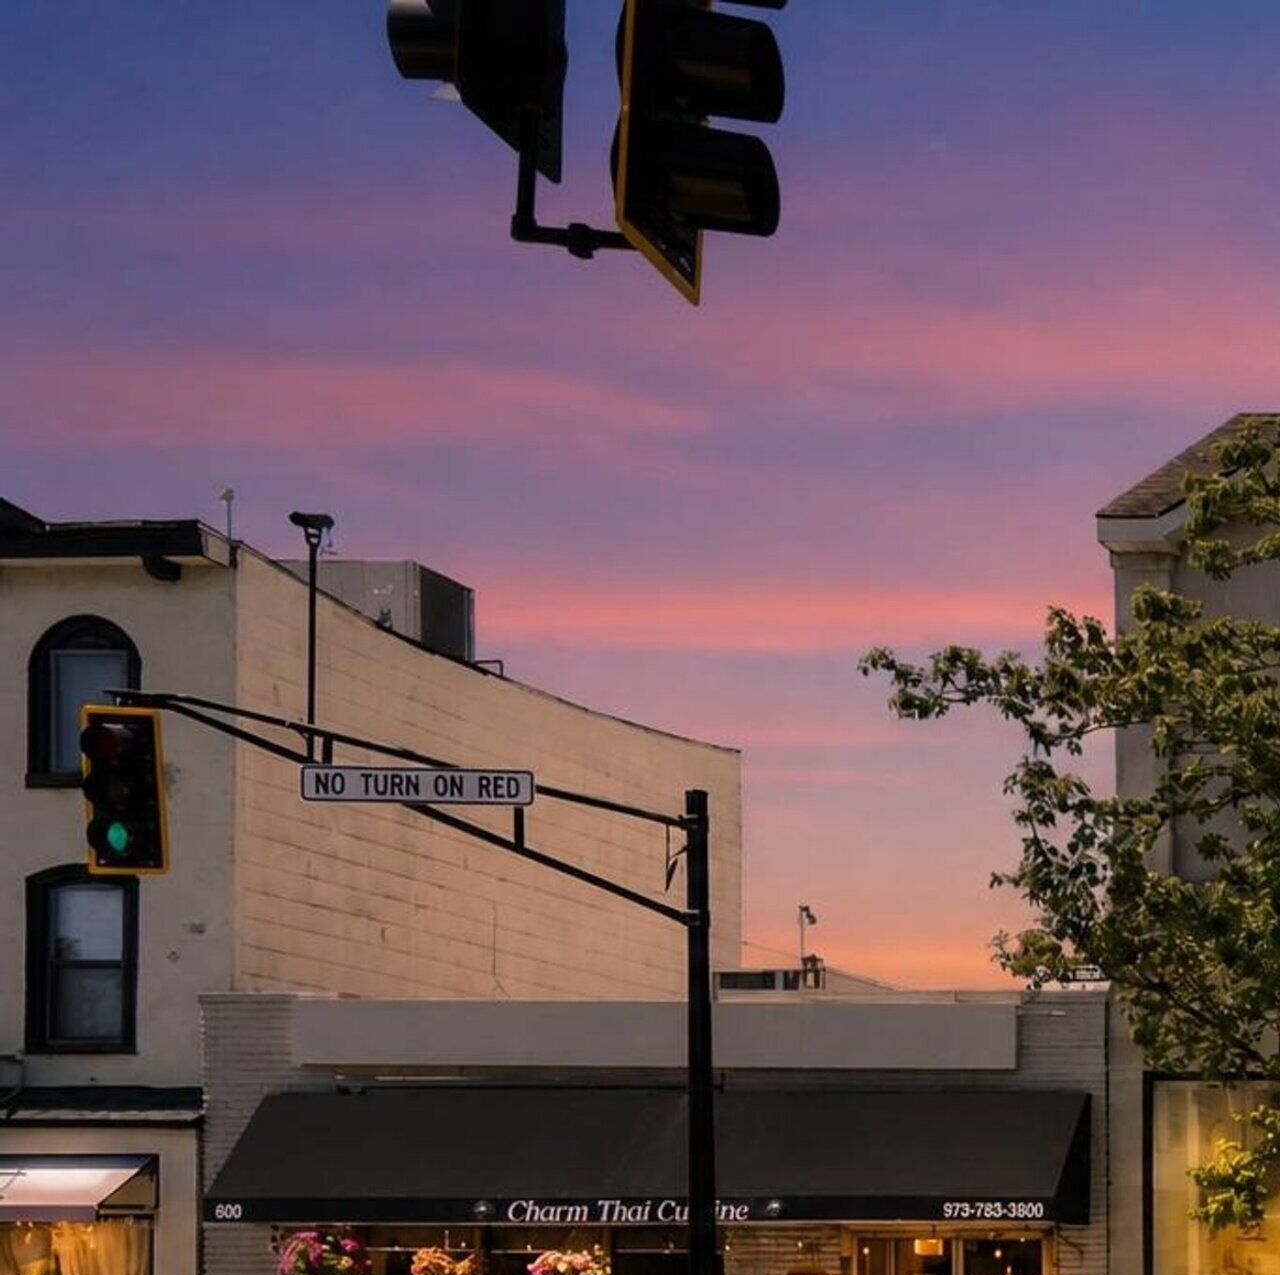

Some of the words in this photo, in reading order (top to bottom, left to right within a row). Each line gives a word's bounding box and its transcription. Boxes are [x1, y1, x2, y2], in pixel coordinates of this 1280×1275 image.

[314, 772, 346, 795] NO
[360, 773, 420, 797] TURN
[433, 774, 464, 797] ON
[478, 776, 521, 799] RED
[215, 1203, 242, 1219] 600
[507, 1200, 589, 1222] Charm
[598, 1200, 652, 1222] Thai
[657, 1200, 750, 1222] Cuine
[943, 1202, 1044, 1218] 973-783-3800
